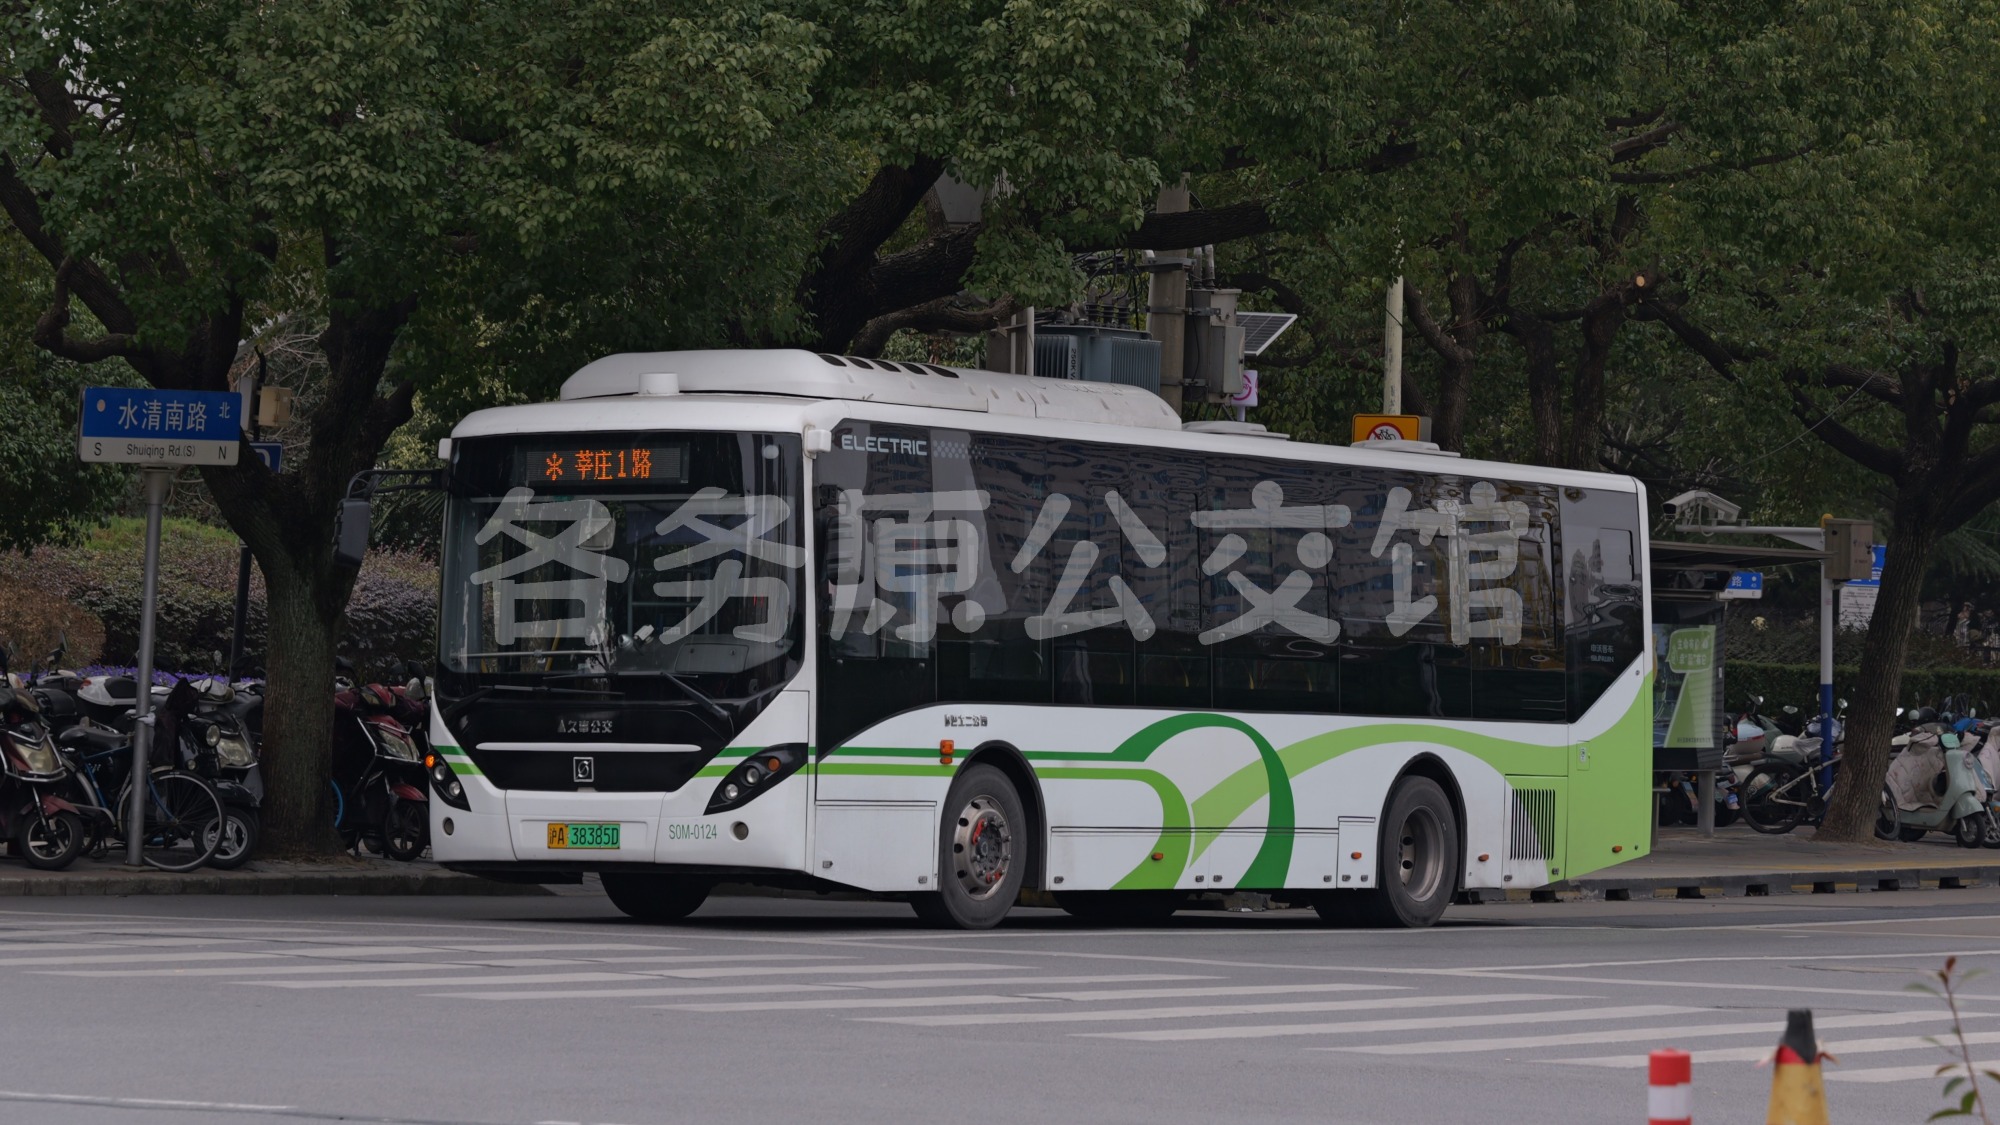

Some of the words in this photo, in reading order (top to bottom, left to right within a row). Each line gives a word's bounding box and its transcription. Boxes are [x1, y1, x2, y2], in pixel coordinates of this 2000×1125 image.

[118, 398, 207, 432] 水清南路
[219, 402, 231, 419] 北
[94, 442, 102, 456] S
[126, 443, 165, 459] Shuiqing
[218, 446, 227, 460] N
[841, 434, 928, 456] ELECTRIC
